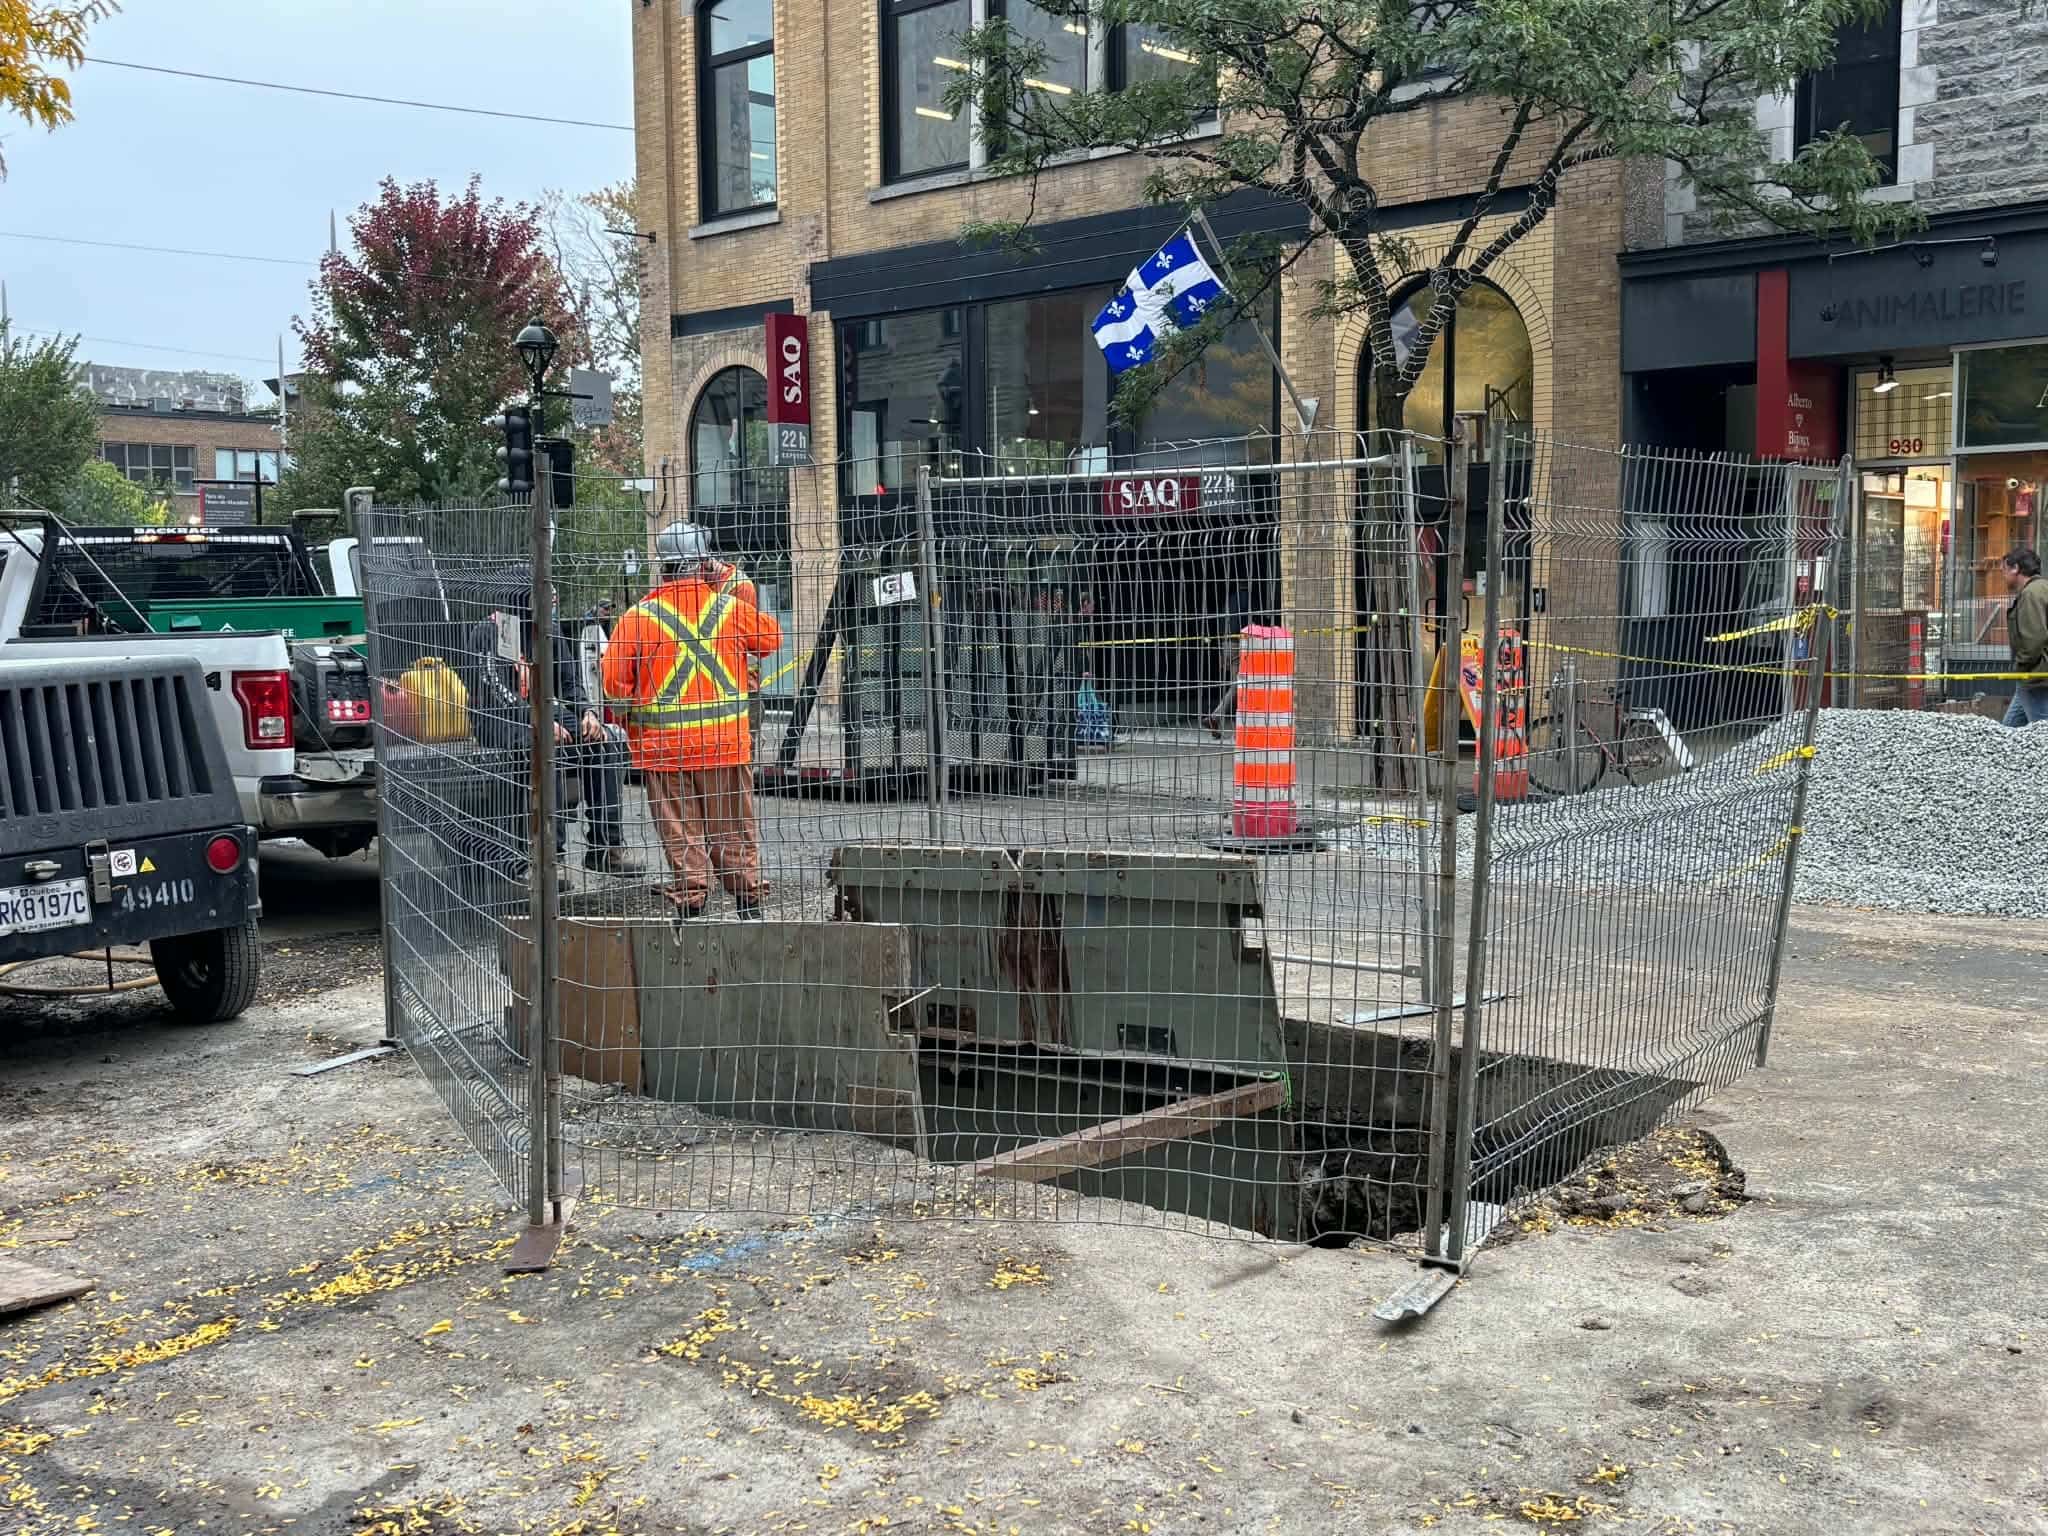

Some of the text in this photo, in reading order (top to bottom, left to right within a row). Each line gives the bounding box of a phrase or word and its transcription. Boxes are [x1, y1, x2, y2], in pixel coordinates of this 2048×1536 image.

[782, 335, 802, 404] SAQ
[782, 430, 807, 449] 22 h
[1890, 438, 1923, 455] 930
[1120, 478, 1179, 509] SAQ
[0, 890, 86, 925] RK8197C
[120, 878, 195, 913] 49410
